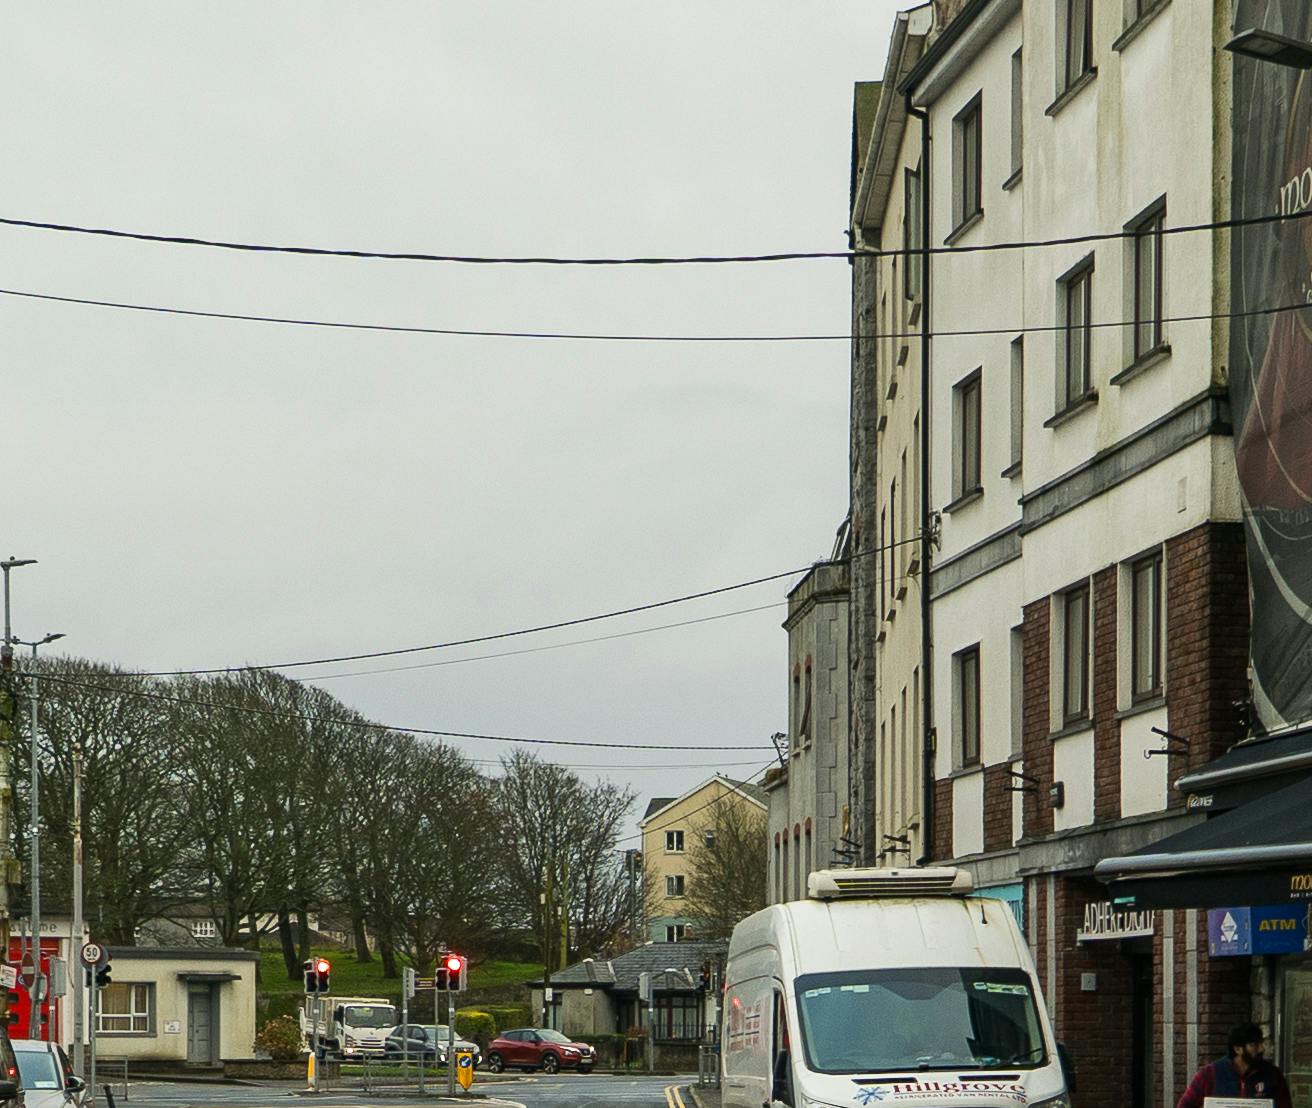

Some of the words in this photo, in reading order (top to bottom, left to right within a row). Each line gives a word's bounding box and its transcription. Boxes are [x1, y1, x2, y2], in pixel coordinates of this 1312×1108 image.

[1259, 918, 1297, 931] ATM
[86, 947, 98, 958] 50
[893, 1081, 1027, 1093] Hillgrove
